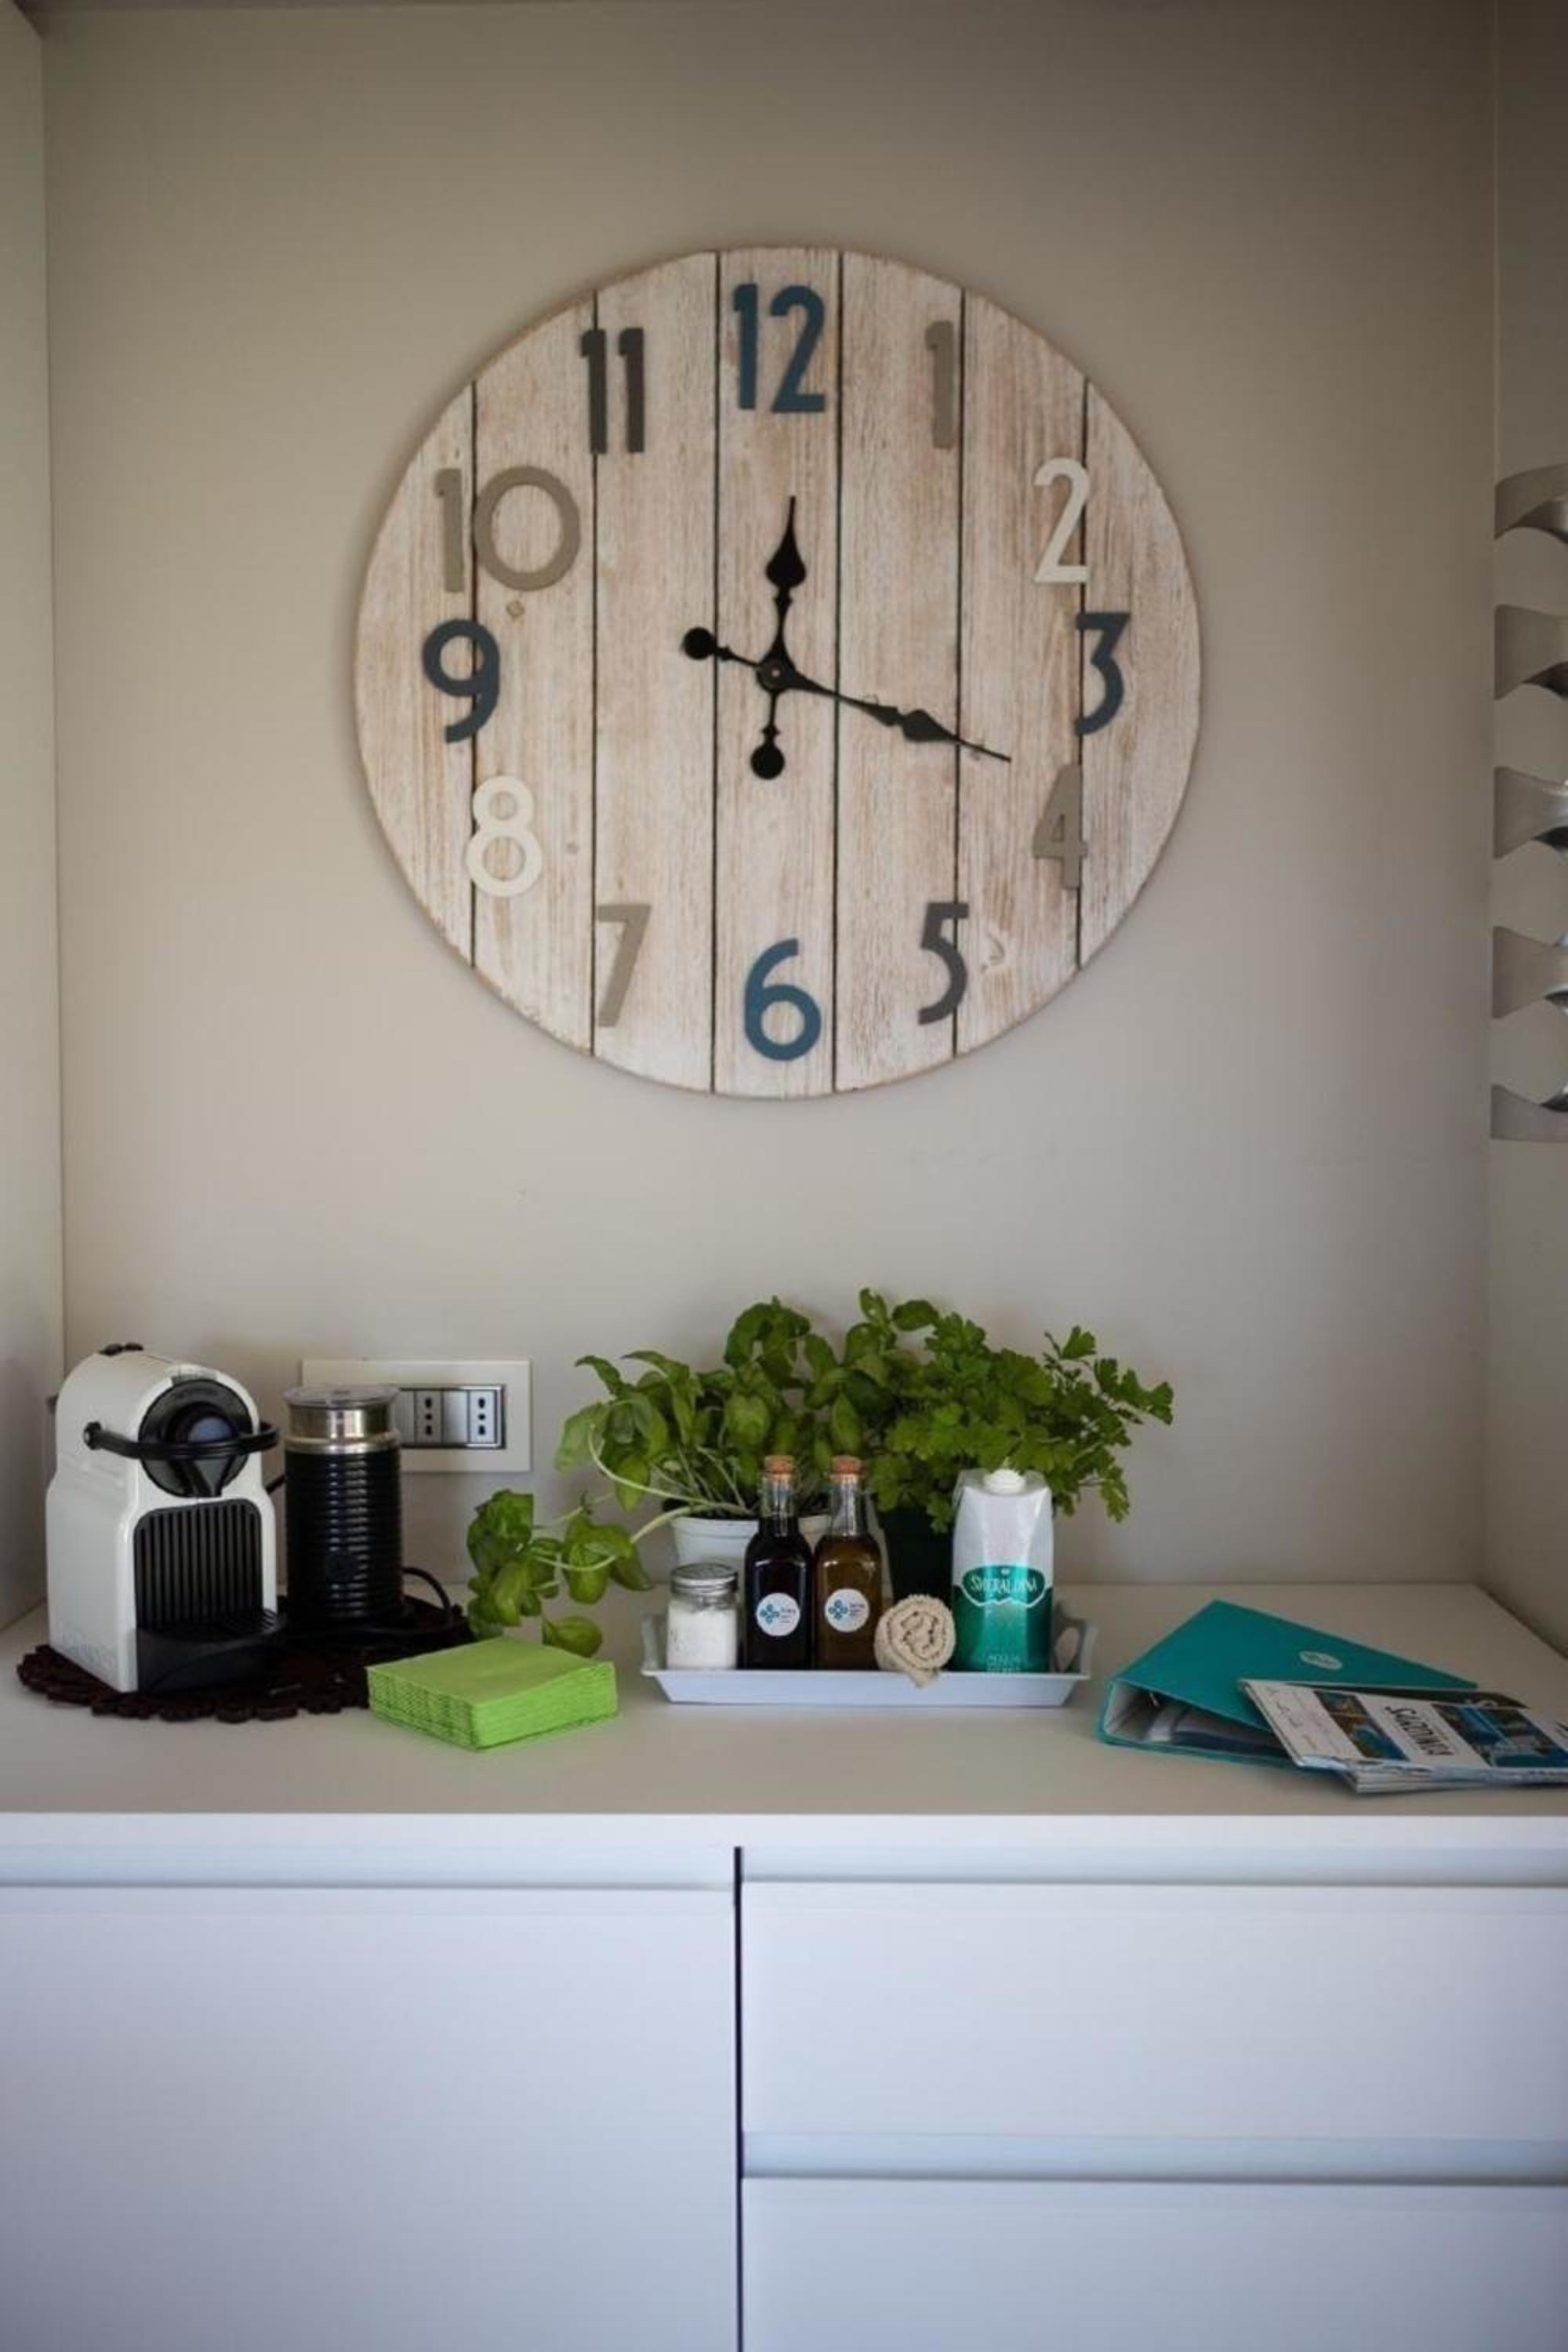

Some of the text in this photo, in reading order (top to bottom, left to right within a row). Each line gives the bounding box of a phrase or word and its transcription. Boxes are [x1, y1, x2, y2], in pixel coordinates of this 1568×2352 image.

[580, 326, 644, 454] 11
[732, 283, 826, 413] 12
[924, 320, 954, 449] 1
[433, 466, 581, 593] 10
[1031, 458, 1091, 583] 2
[422, 619, 500, 744] 9
[1074, 612, 1130, 735] 3
[466, 775, 542, 898] 8
[1031, 763, 1087, 889] 4
[596, 904, 652, 1027] 7
[744, 938, 821, 1061] 6
[918, 902, 968, 1025] 5
